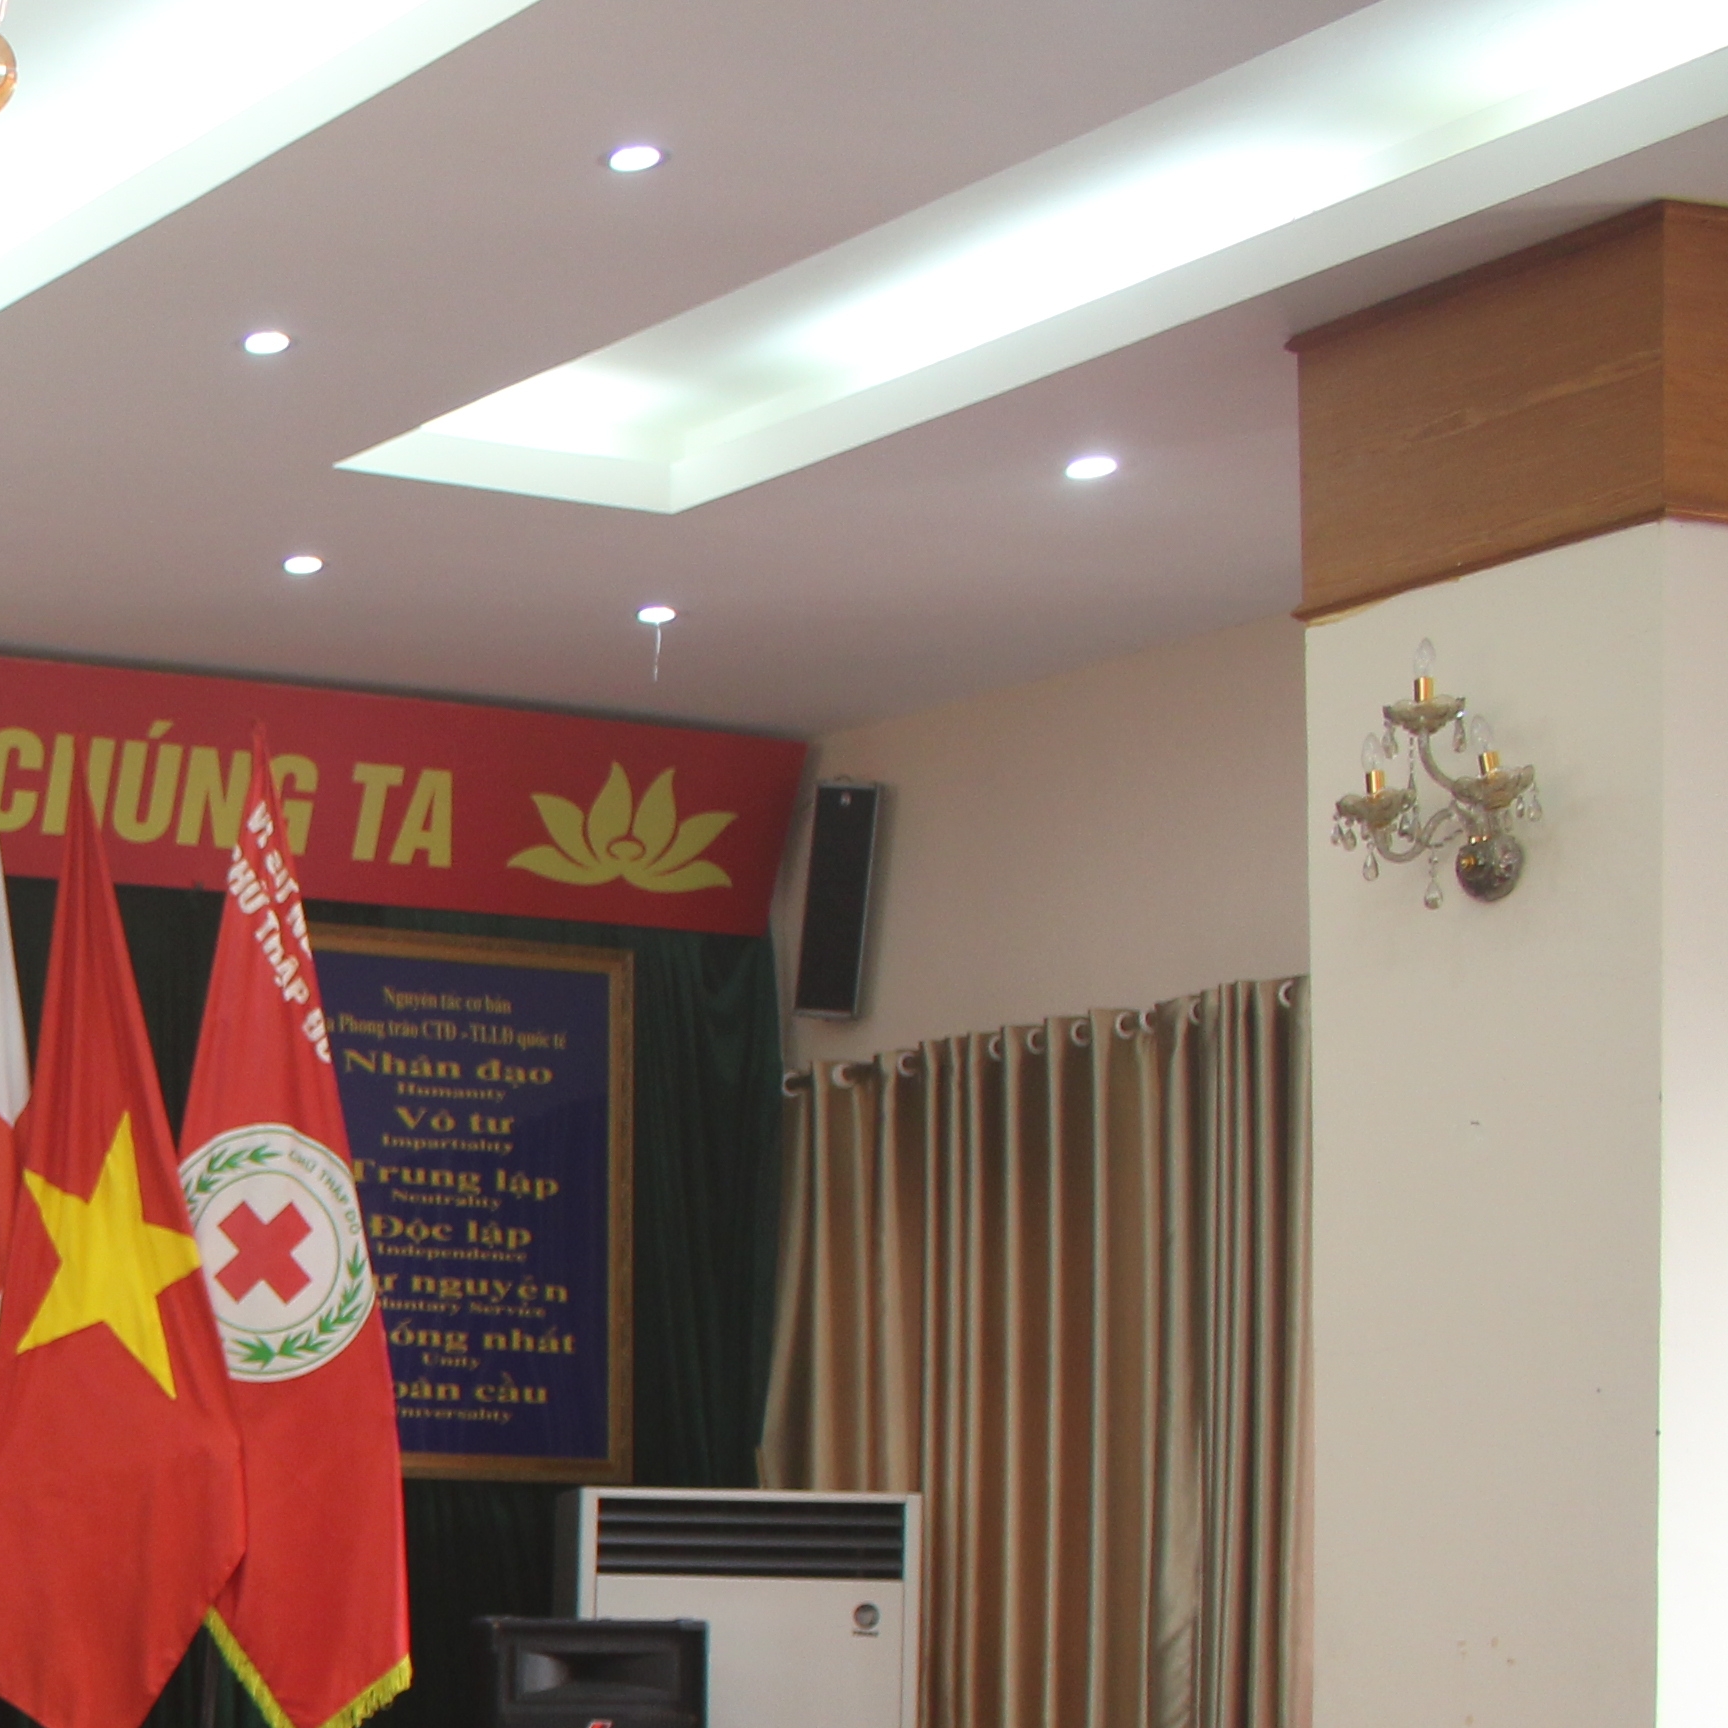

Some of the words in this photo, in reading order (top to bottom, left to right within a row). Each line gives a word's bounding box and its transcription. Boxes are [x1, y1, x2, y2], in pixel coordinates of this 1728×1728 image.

[351, 762, 453, 869] TA
[339, 1013, 385, 1039] Phong
[344, 1048, 461, 1079] Nhân
[476, 1058, 554, 1088] đạo
[395, 1106, 456, 1132] Vô
[469, 1112, 516, 1135] tư
[352, 1158, 482, 1195] Trung
[496, 1168, 560, 1201] lập
[369, 1213, 453, 1245] Độc
[467, 1219, 532, 1250] lập
[372, 1273, 399, 1295] ự
[411, 1274, 569, 1303] nguyện
[379, 1296, 462, 1316] luntary
[390, 1318, 469, 1353] ống
[483, 1325, 576, 1355] nhất
[474, 1371, 548, 1404] cầu
[399, 1405, 513, 1425] niversality
